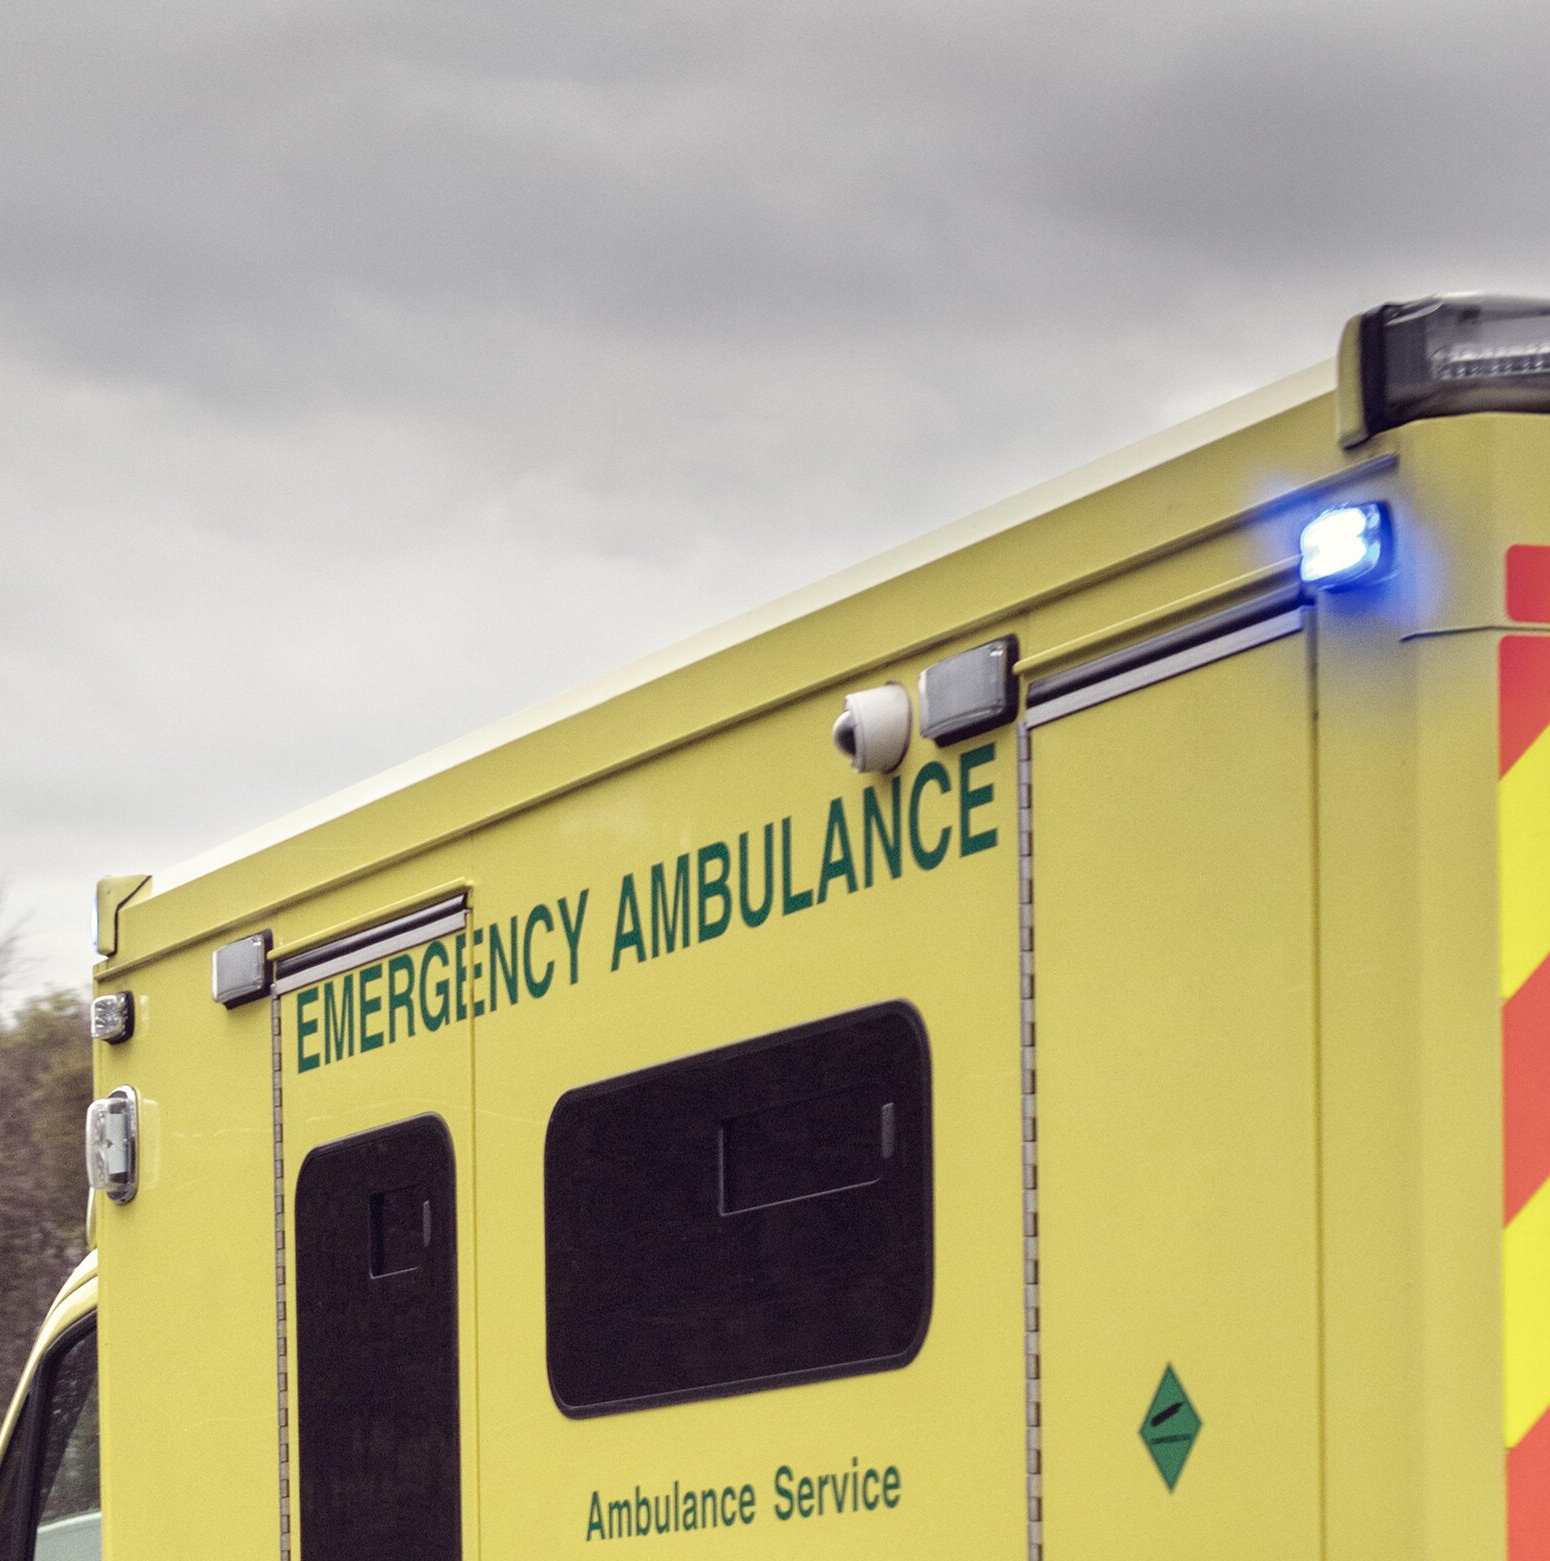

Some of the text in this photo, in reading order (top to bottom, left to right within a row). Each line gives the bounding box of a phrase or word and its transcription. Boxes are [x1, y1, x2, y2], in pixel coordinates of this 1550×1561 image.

[297, 742, 998, 1074] EMERGENCY AMBULANCE
[586, 1456, 901, 1542] Ambulance Service
